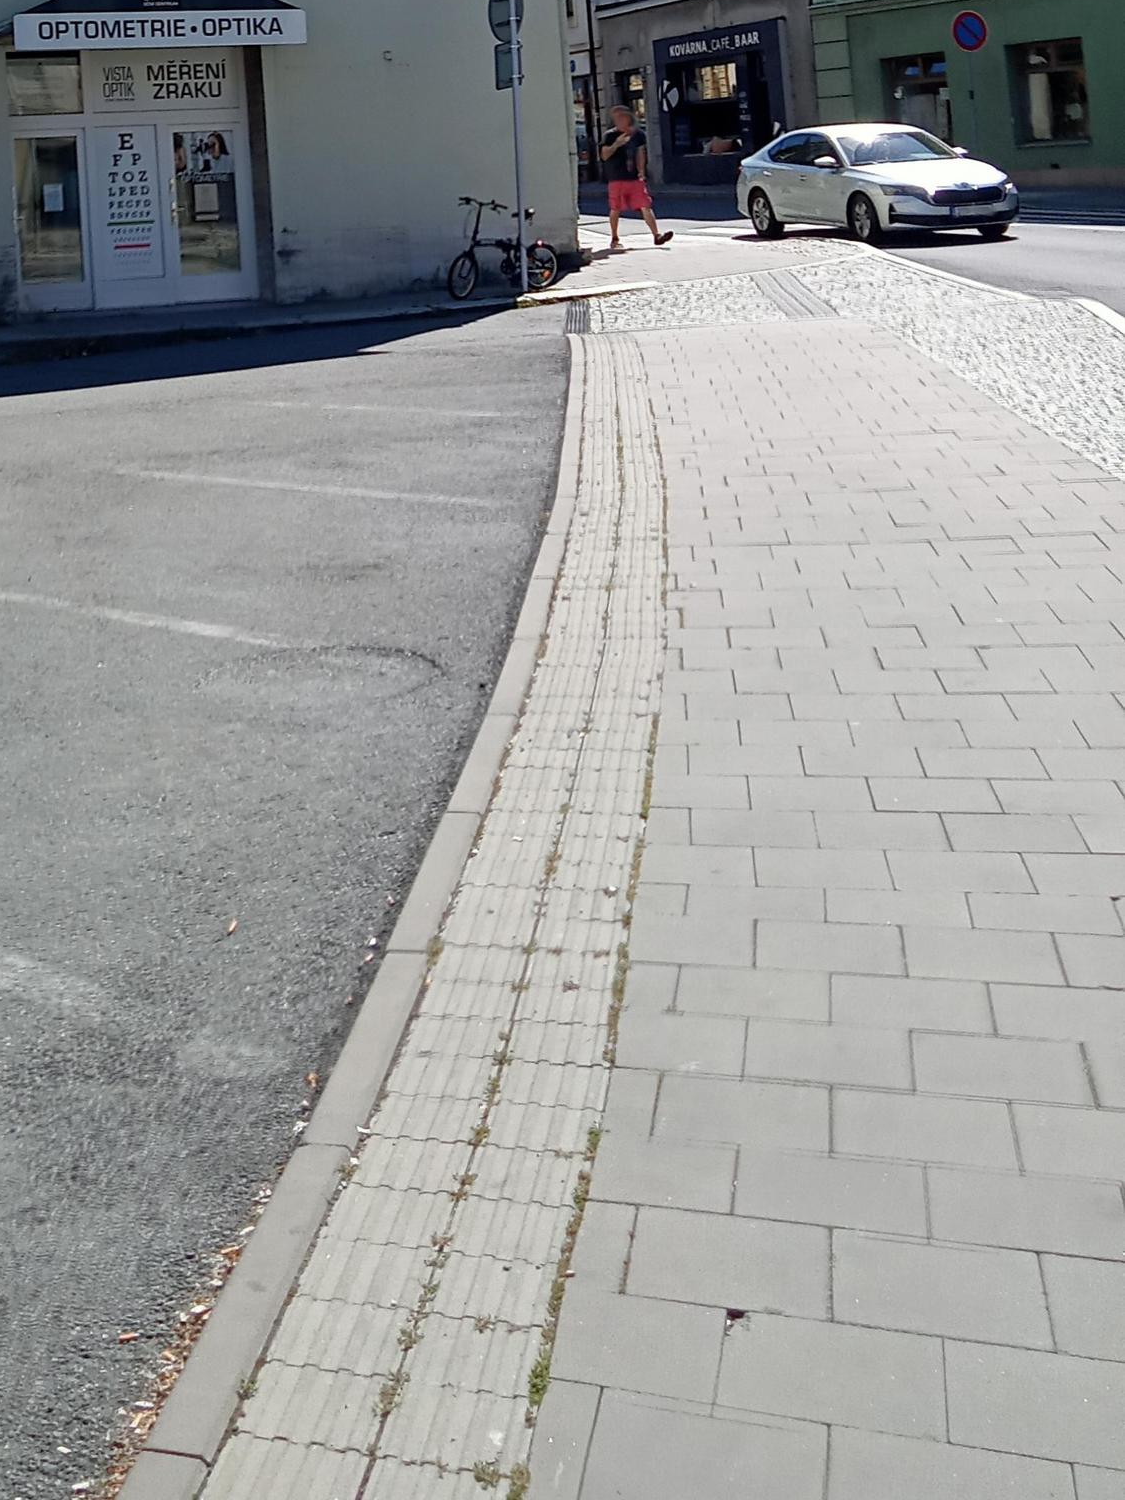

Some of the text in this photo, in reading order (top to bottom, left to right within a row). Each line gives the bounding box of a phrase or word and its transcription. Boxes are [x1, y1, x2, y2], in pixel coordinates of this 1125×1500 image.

[38, 17, 284, 40] OPTOMETRIE OPTIKA
[103, 66, 134, 81] VISTA
[146, 58, 226, 81] MĚŘENÍ
[103, 82, 135, 98] OPTIK
[152, 81, 222, 100] ZRAKU
[118, 133, 134, 150] E
